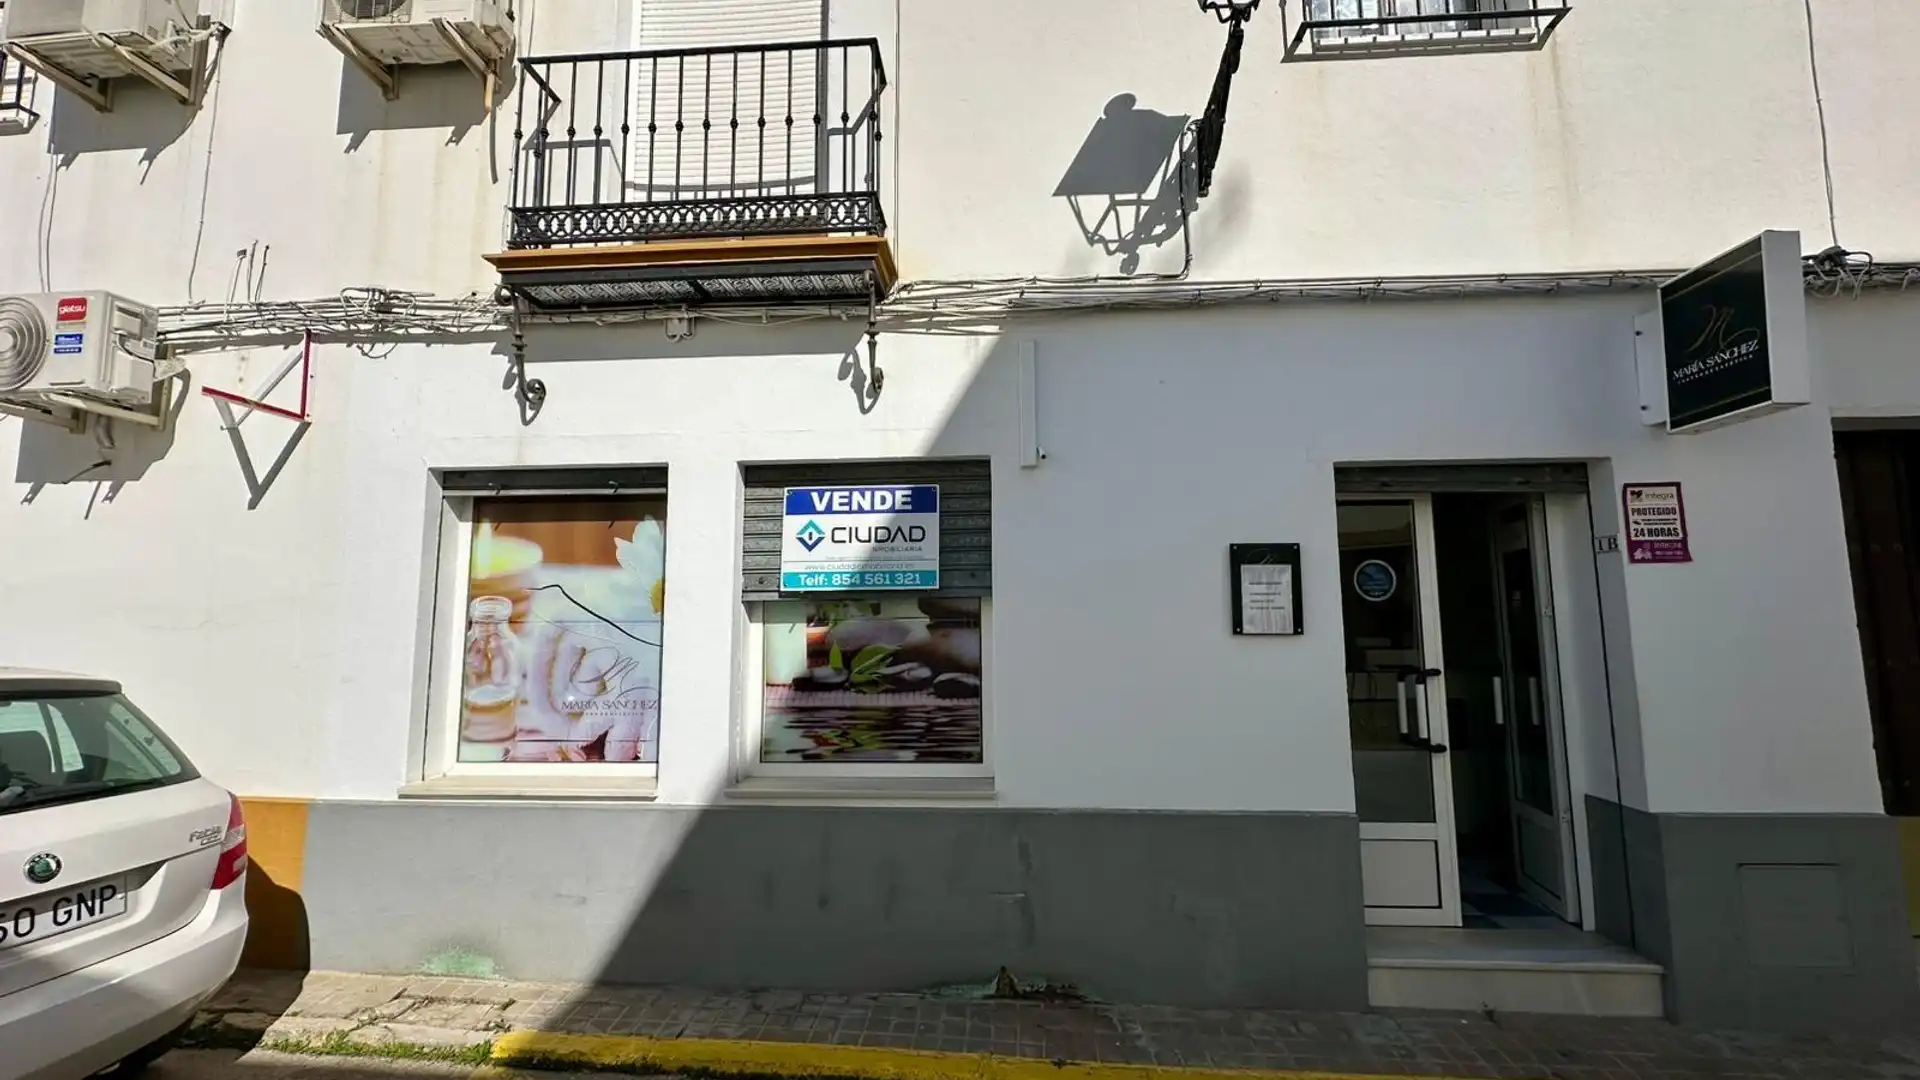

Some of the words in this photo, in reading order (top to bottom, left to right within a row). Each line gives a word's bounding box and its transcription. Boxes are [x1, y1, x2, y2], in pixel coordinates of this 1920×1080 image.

[810, 489, 912, 511] VENDE
[1631, 506, 1677, 516] PROTEGIDO
[831, 526, 926, 544] CIUDAD
[1632, 527, 1646, 538] 24
[1647, 527, 1680, 537] HORAS
[798, 574, 829, 587] Telf:
[831, 573, 861, 586] 854
[864, 573, 891, 585] 561
[894, 573, 921, 585] 321
[52, 884, 118, 927] GNP
